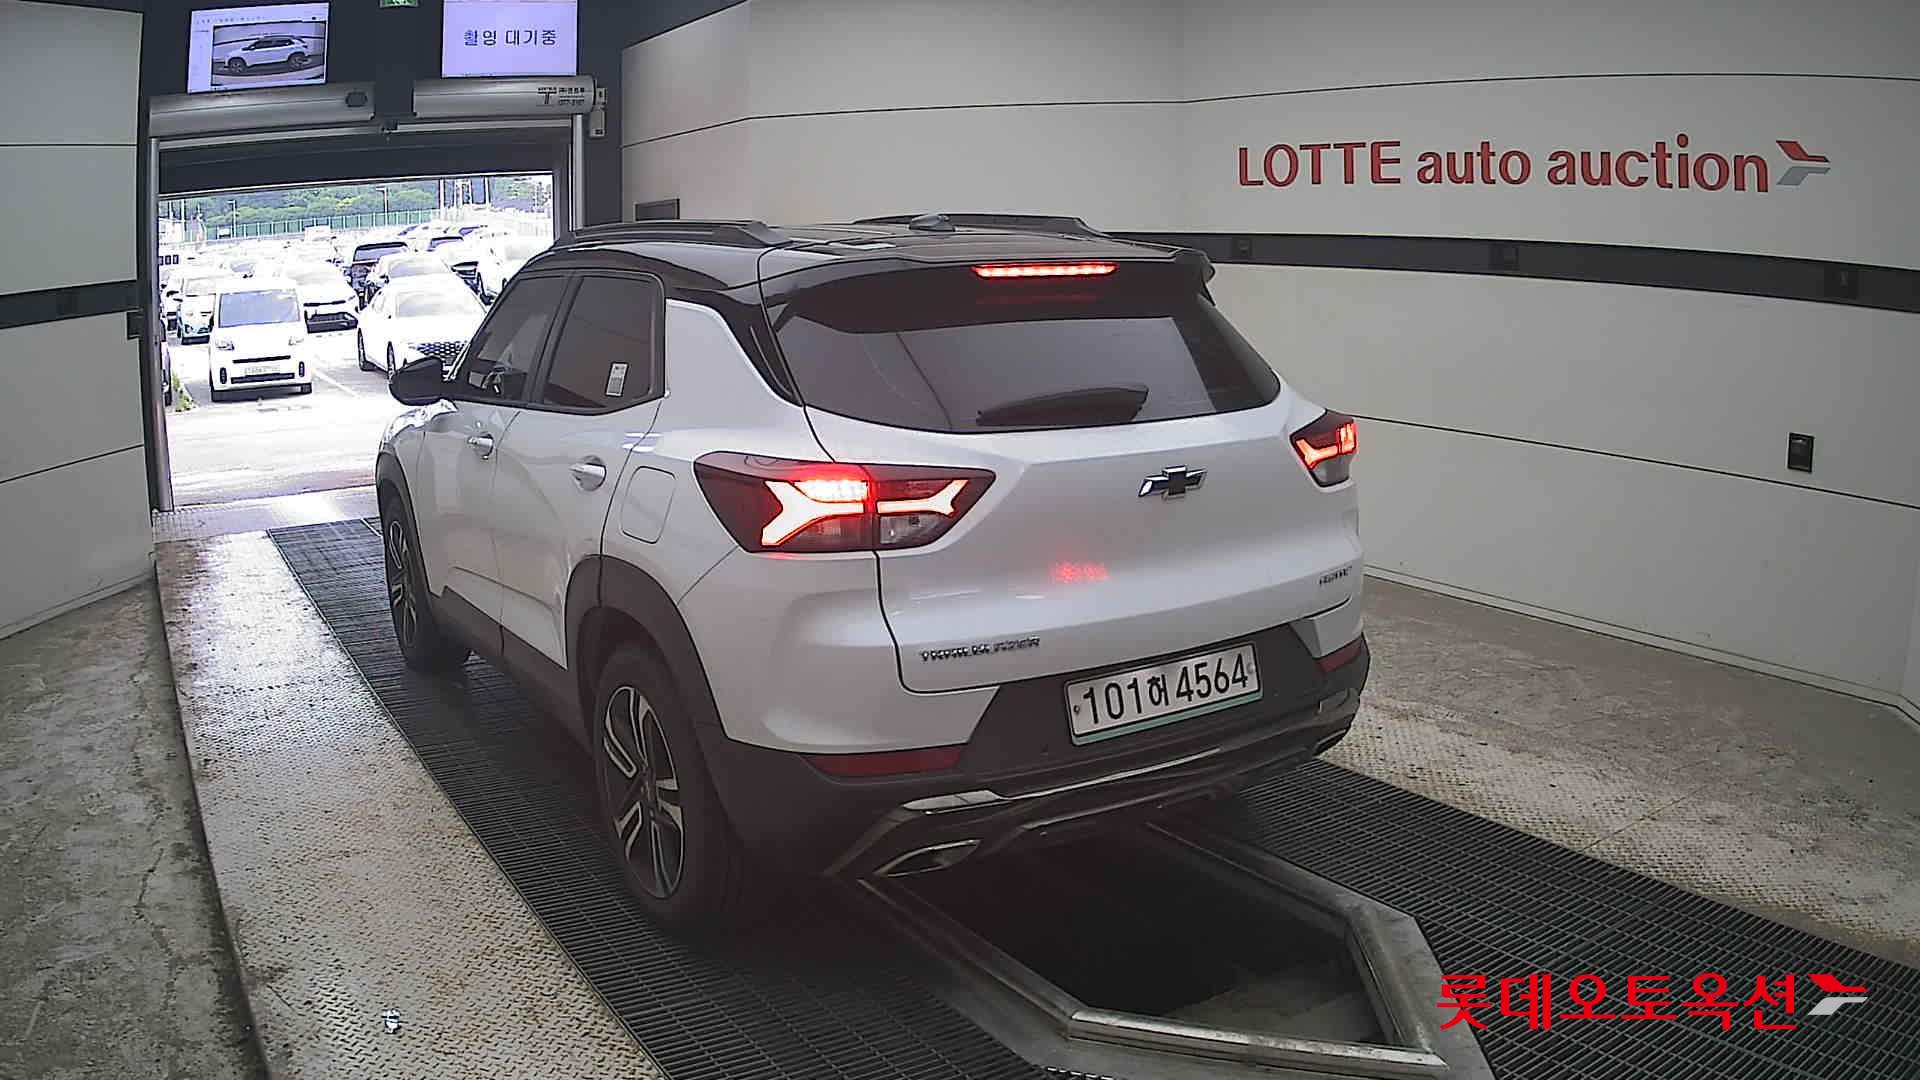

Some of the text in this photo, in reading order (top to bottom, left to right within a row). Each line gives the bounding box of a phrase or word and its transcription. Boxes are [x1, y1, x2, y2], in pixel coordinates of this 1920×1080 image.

[505, 29, 557, 47] 대기중
[1238, 132, 1770, 194] LOTTE auto auction
